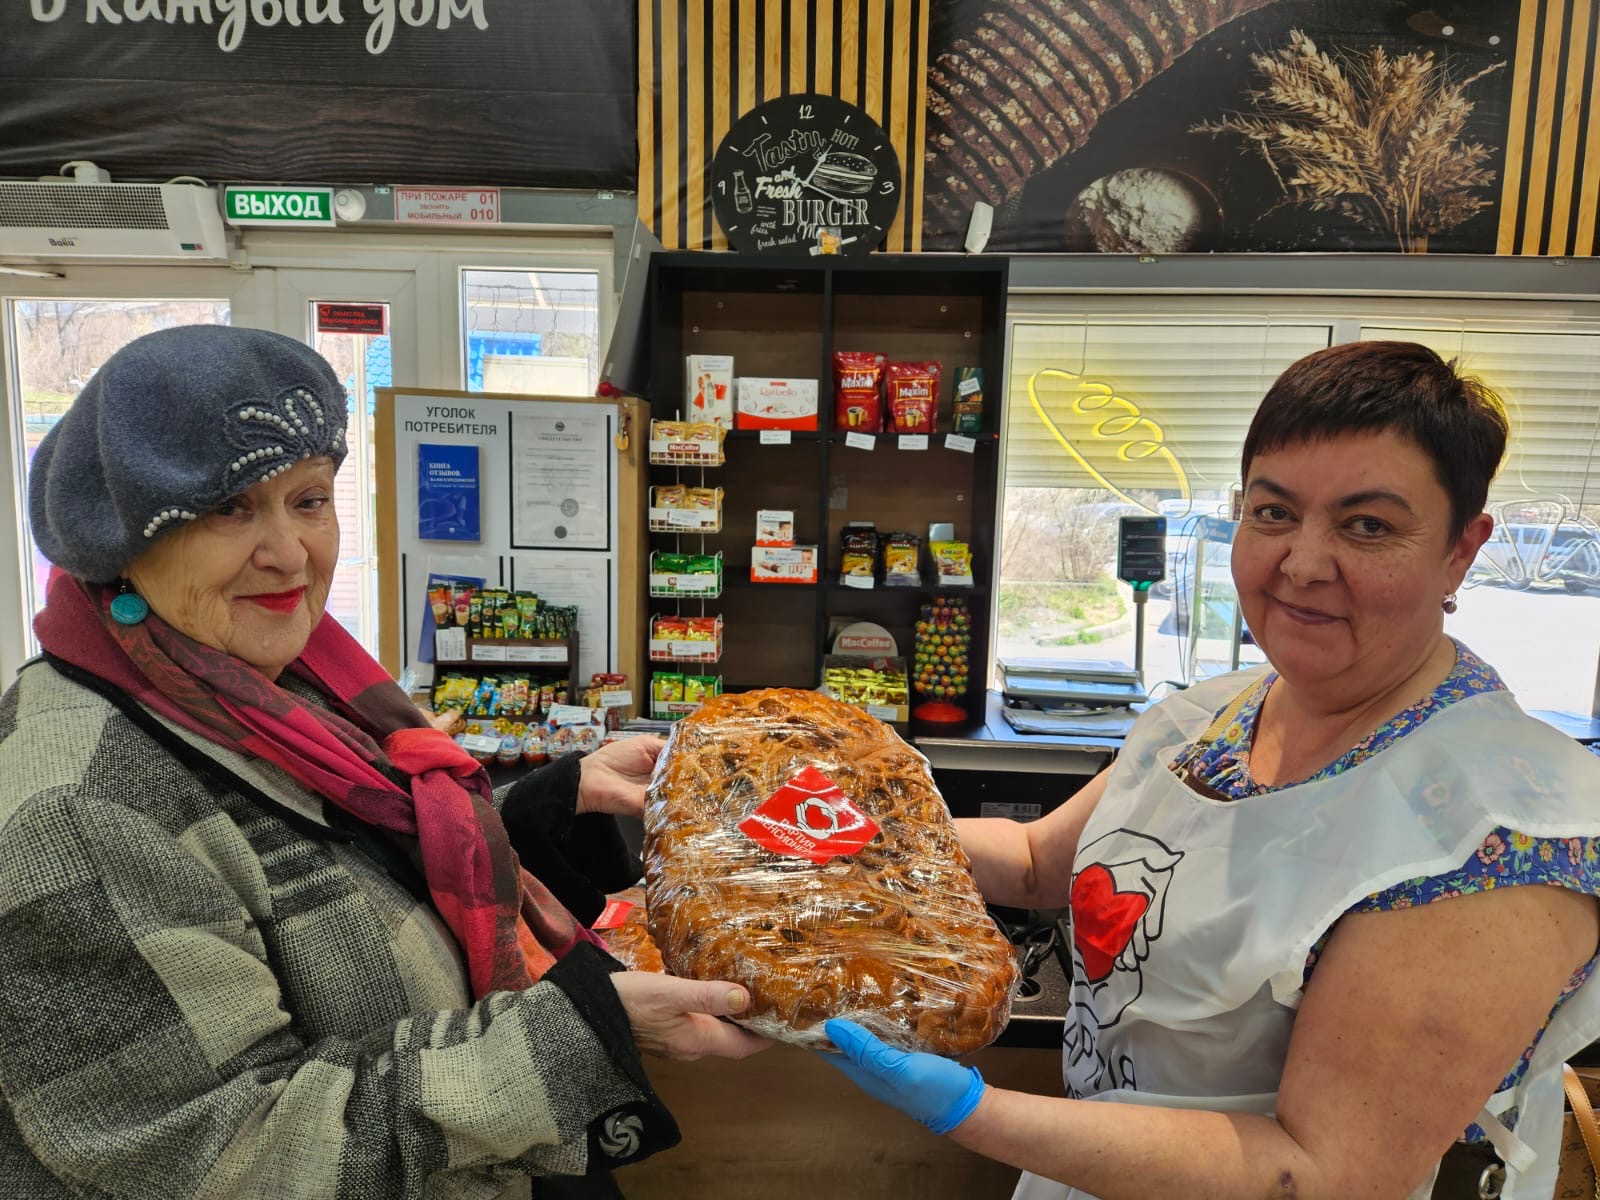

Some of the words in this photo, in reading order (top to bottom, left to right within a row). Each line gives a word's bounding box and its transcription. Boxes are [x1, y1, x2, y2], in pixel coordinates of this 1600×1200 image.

[799, 104, 815, 119] 12
[831, 129, 860, 150] HOT!
[742, 129, 827, 174] Tasty
[717, 180, 726, 196] 9
[755, 176, 803, 199] Fresh
[880, 181, 895, 195] 3
[234, 193, 323, 218] ВЫХОД
[400, 192, 421, 200] ПРИ
[424, 192, 468, 201] ПОЖАРЕ
[479, 193, 494, 205] 01
[470, 208, 494, 220] 010
[782, 198, 870, 226] BURGER
[757, 237, 776, 251] fresh
[778, 233, 798, 246] salad
[841, 375, 873, 389] Maxim
[899, 386, 929, 398] Maxim
[426, 406, 476, 419] УГОЛОК
[405, 421, 497, 435] ПОТРЕБИТЕЛЯ
[841, 638, 891, 648] MacCoffee
[779, 818, 816, 850] ПАРТИЯ
